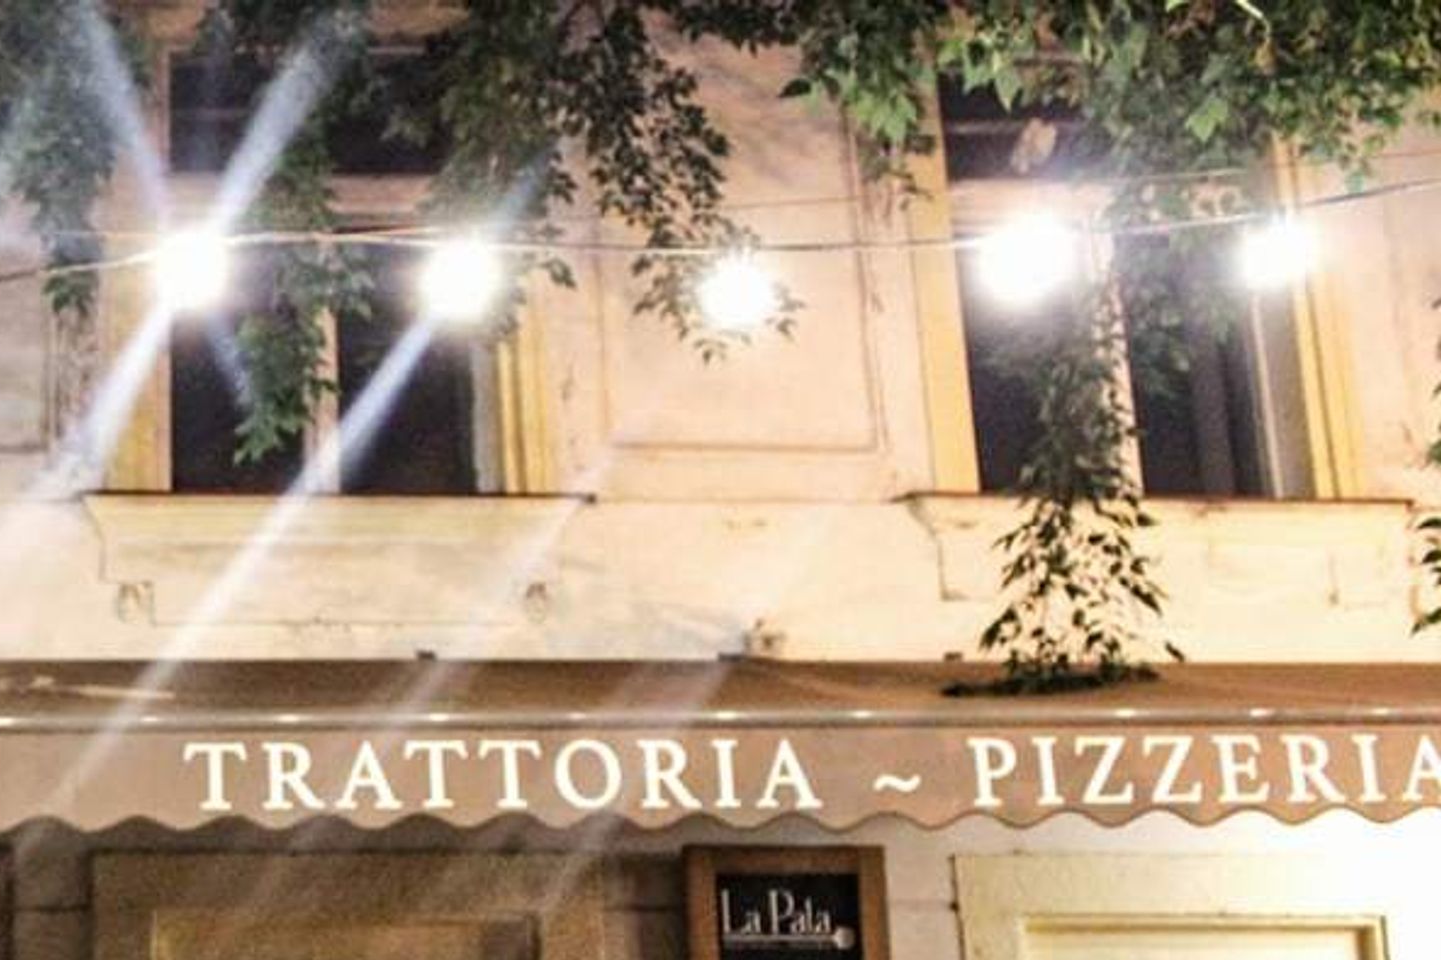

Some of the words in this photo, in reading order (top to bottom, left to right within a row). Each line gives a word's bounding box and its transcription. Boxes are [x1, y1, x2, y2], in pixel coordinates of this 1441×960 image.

[183, 736, 822, 812] TRATTORIA
[968, 733, 1441, 807] PIZZERIA
[720, 889, 761, 935] La
[768, 888, 831, 935] Pala
